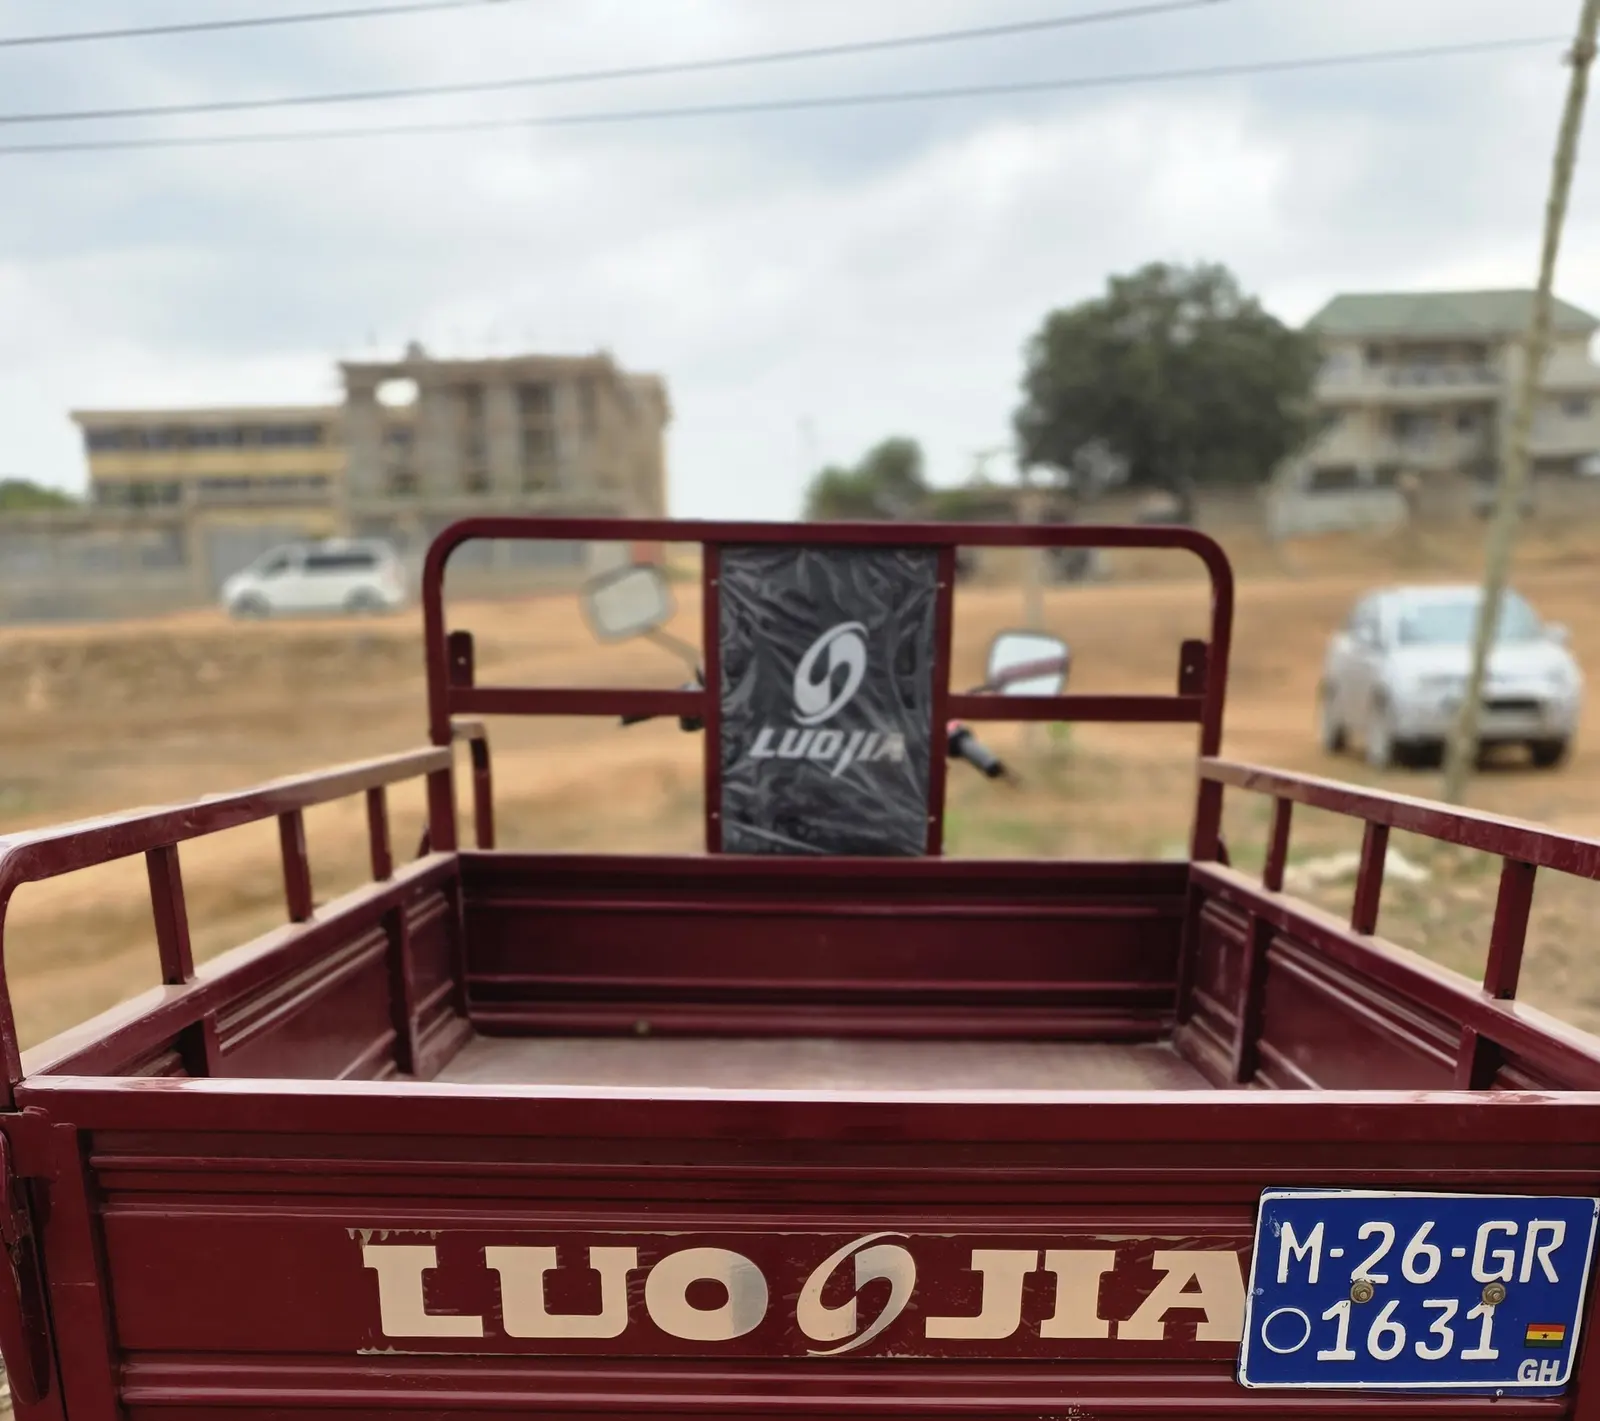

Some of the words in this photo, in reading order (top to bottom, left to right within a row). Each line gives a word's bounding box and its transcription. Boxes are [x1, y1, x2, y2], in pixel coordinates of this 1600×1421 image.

[749, 727, 906, 778] LUOJIA
[1276, 1220, 1567, 1285] M-26-GR
[361, 1244, 769, 1341] LUO
[925, 1248, 1248, 1342] JIA
[1316, 1299, 1500, 1361] 1631
[1516, 1358, 1560, 1382] GH
